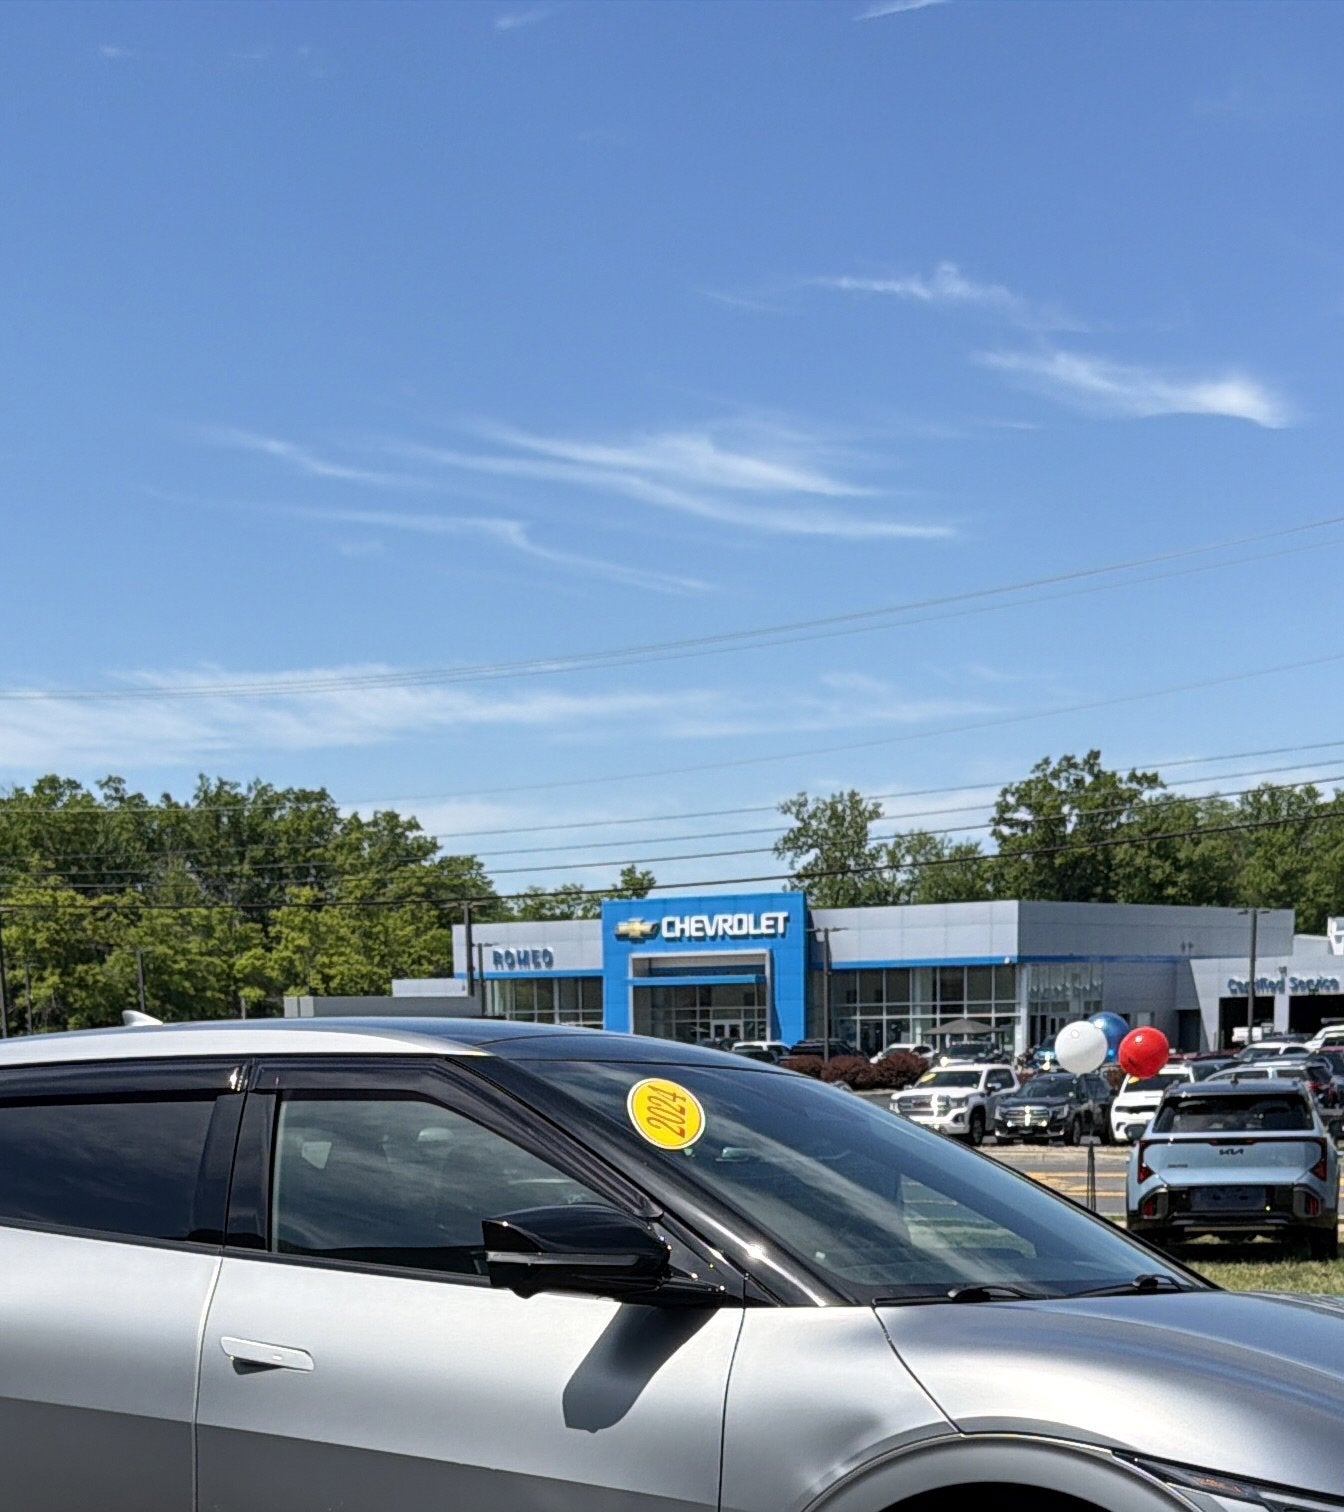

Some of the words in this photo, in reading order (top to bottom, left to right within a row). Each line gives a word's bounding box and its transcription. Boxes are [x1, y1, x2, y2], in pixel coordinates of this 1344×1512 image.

[661, 911, 789, 939] CHEVROLET
[492, 947, 555, 970] ROMEO
[646, 1084, 687, 1139] 2024
